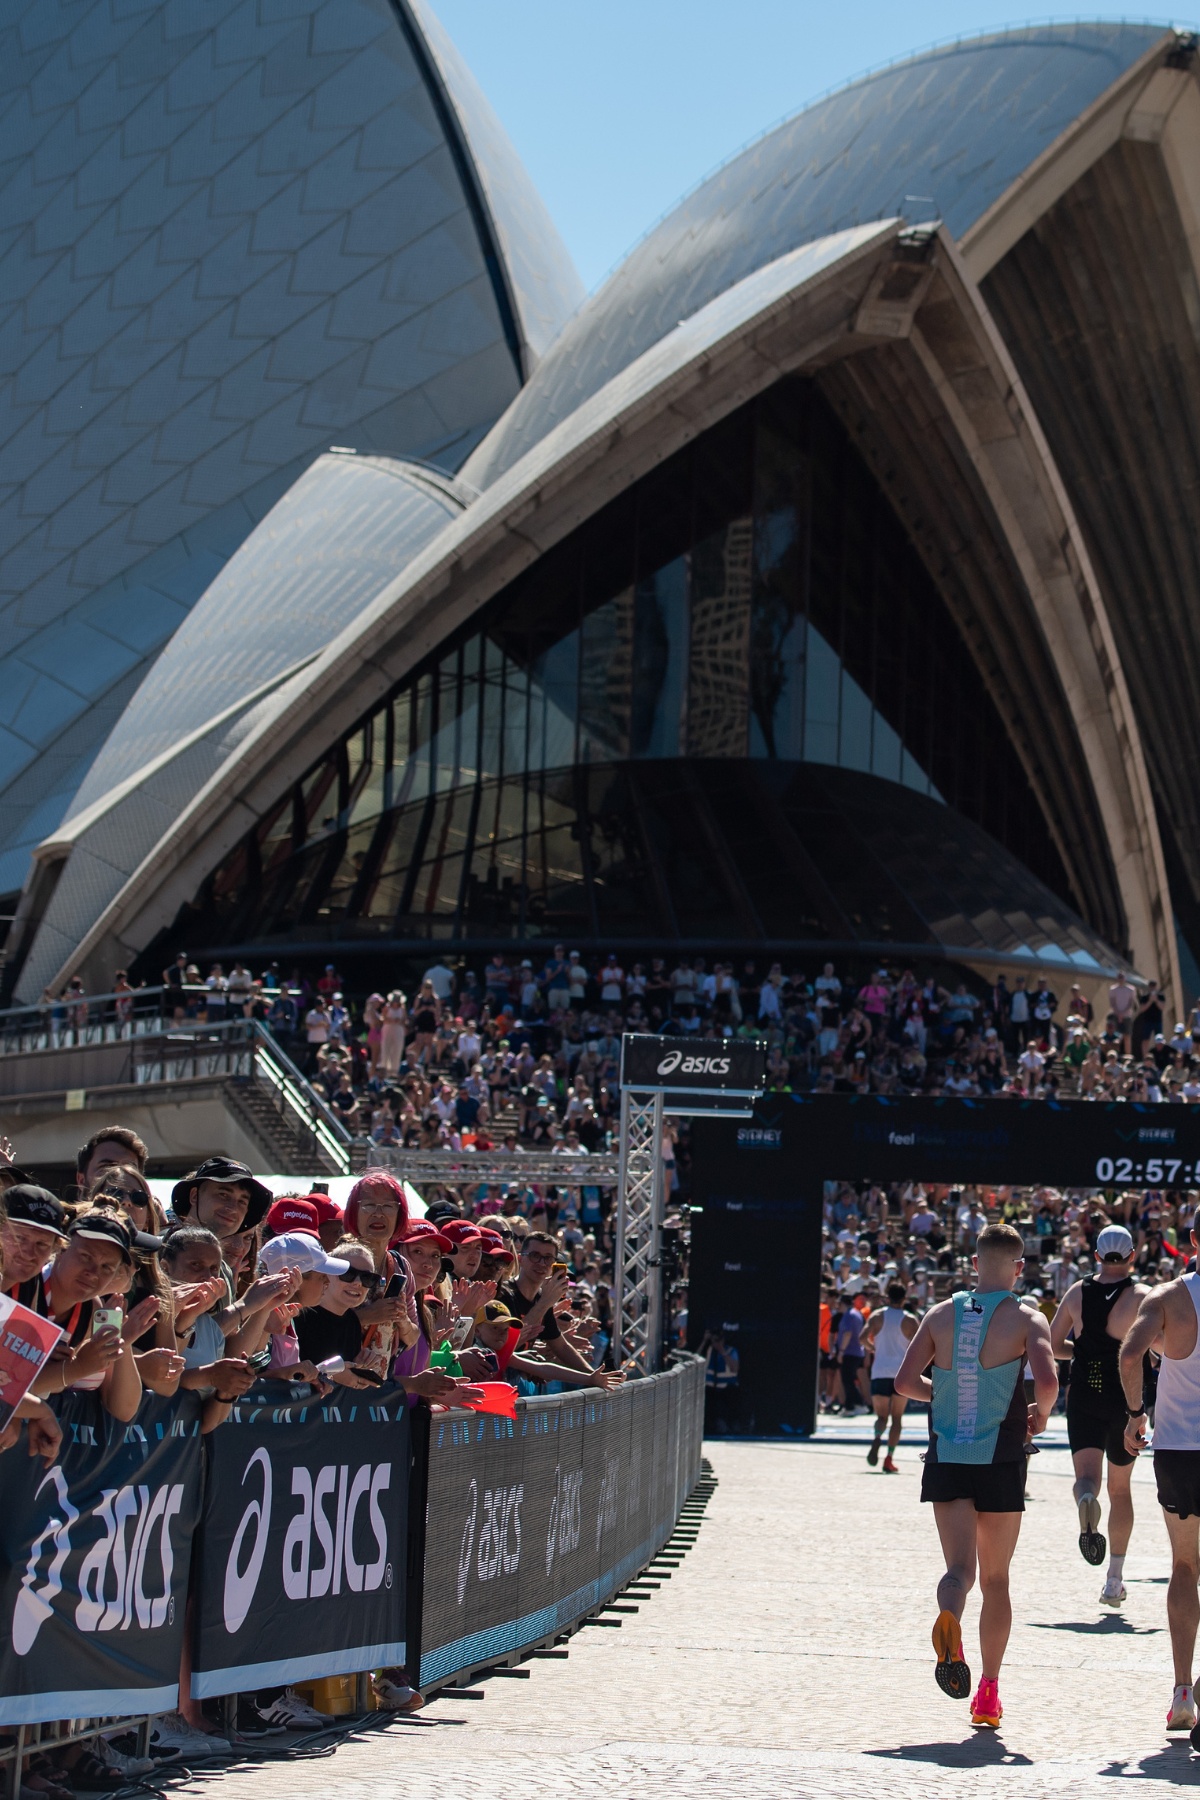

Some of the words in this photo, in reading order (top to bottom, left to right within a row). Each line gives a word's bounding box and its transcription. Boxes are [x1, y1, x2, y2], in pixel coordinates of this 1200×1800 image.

[681, 1056, 731, 1074] asics
[737, 1128, 782, 1142] SYDNEY
[889, 1132, 915, 1145] feel
[3, 1331, 47, 1366] TEAM!
[953, 1362, 979, 1444] RUNNERS
[75, 1484, 185, 1632] asics
[282, 1463, 392, 1600] asics
[478, 1484, 525, 1581] asics
